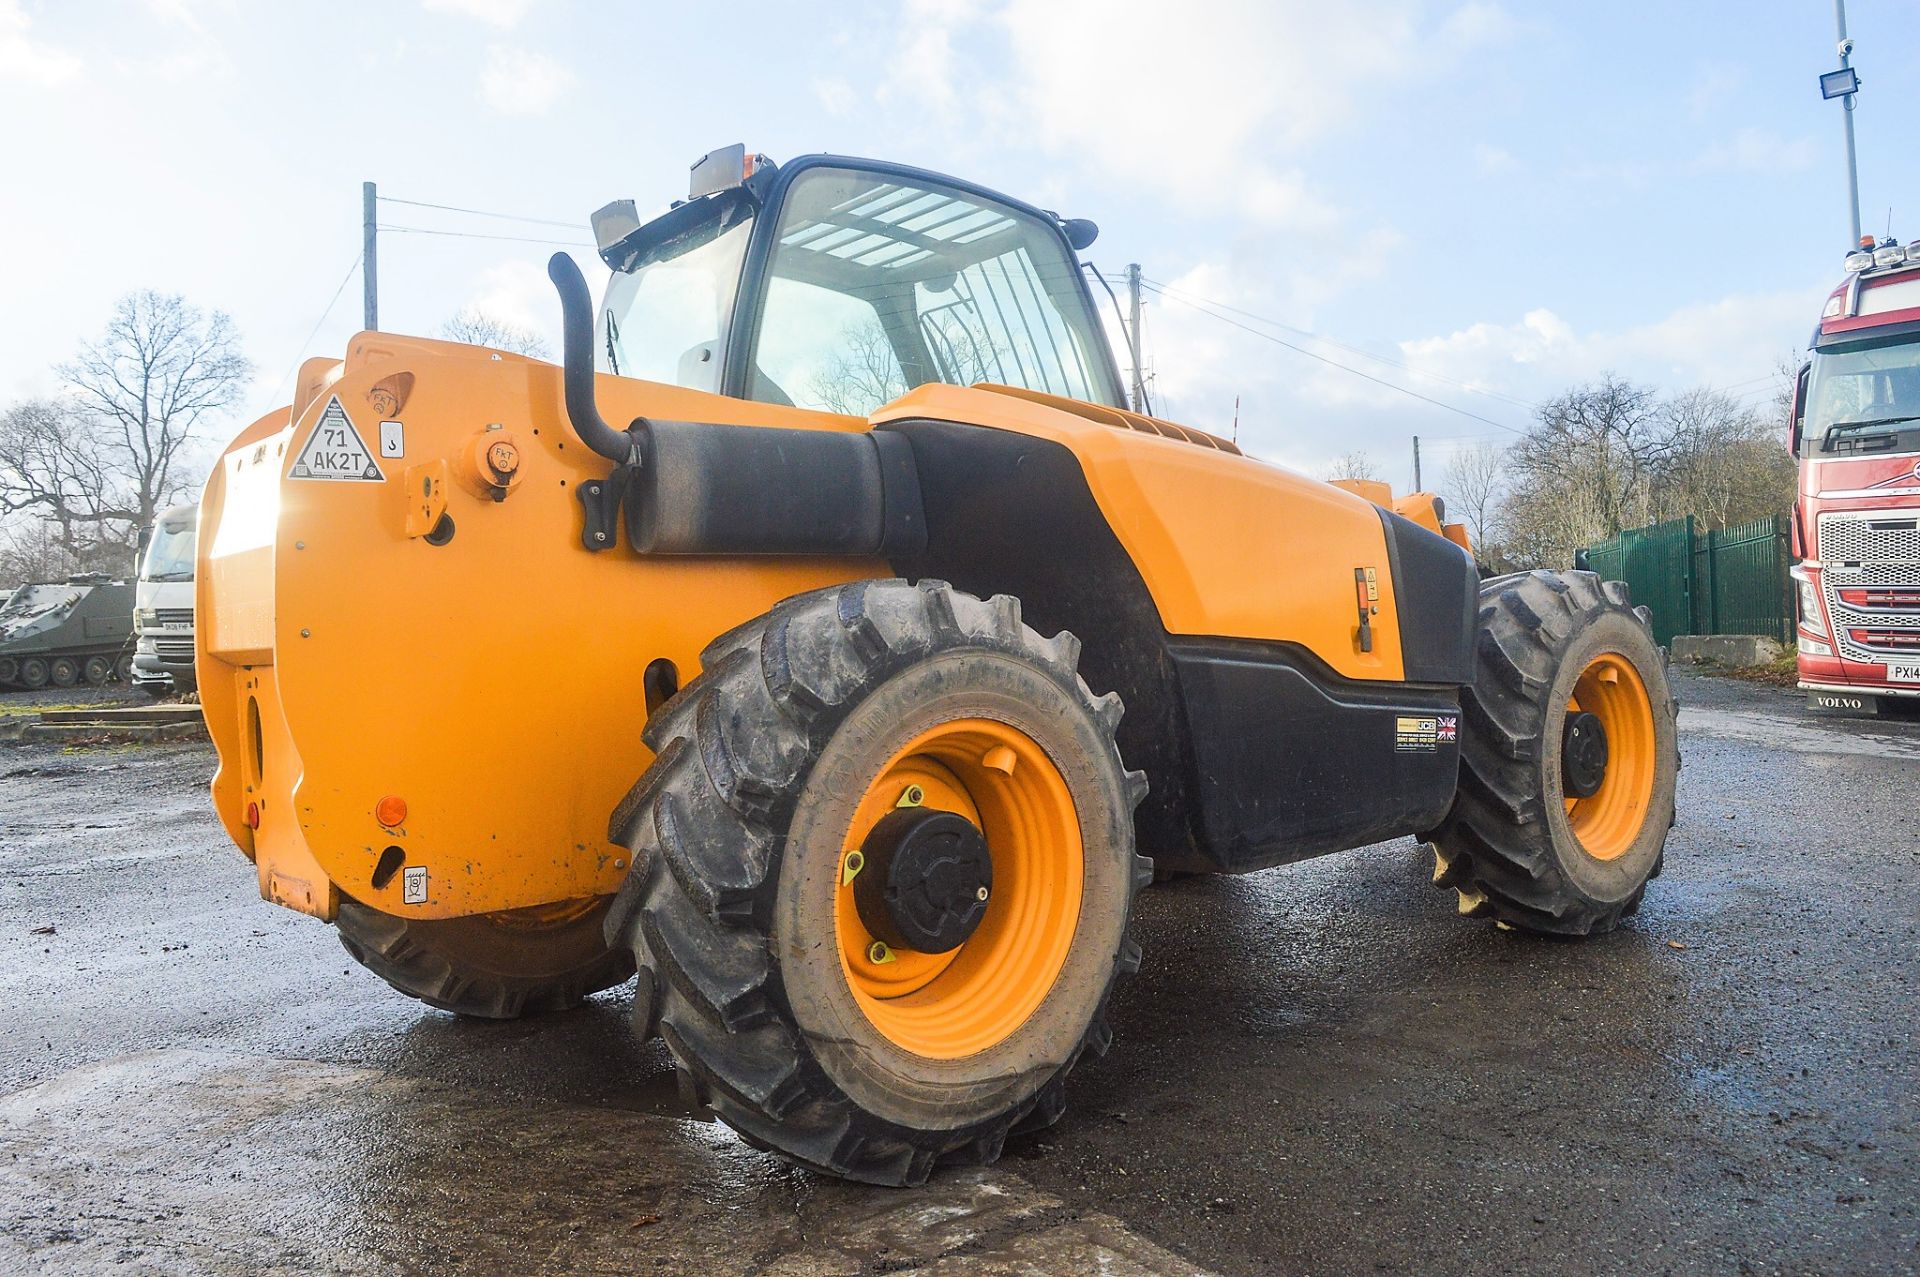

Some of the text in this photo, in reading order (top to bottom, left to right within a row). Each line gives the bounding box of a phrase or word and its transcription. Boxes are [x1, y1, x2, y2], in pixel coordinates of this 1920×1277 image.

[324, 429, 348, 448] 71
[314, 451, 362, 471] AK2T
[1895, 666, 1920, 679] PX14
[1817, 697, 1862, 709] VOLVO
